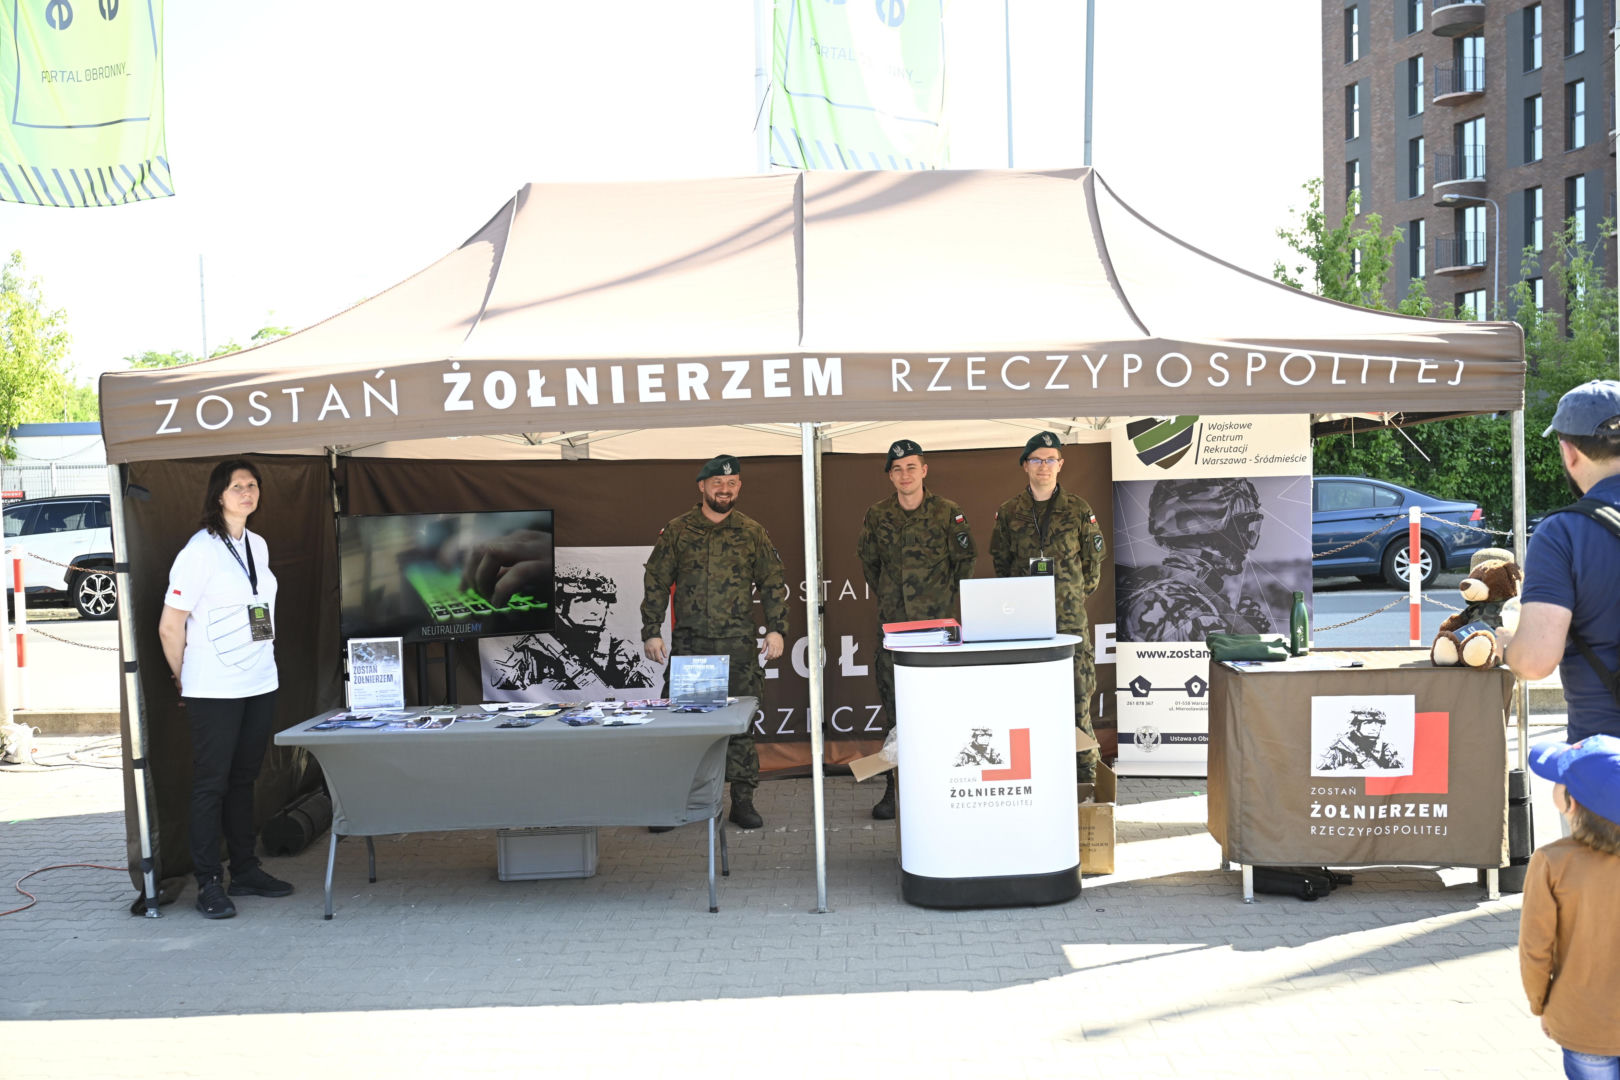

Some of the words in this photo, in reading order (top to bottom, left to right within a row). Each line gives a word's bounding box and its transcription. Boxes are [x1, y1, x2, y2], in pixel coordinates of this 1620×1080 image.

[155, 369, 399, 434] ZOSTAŃ
[443, 357, 843, 412] ŻOŁNIERZEM
[891, 351, 1465, 392] RZECZYPOSPOLITEJ
[1208, 421, 1253, 432] Wojskowe
[1205, 434, 1244, 442] Centrum
[1203, 444, 1249, 454] Rekrutacji
[1202, 457, 1247, 465] Warszawa
[1254, 453, 1308, 464] Śródmieście
[950, 785, 1032, 798] ŻOŁNIERZEM
[1310, 785, 1357, 796] ZOSTAŃ
[1310, 800, 1448, 819] ŻOŁNIERZEM
[1310, 825, 1448, 836] RZECZYPOSPOLITEJ
